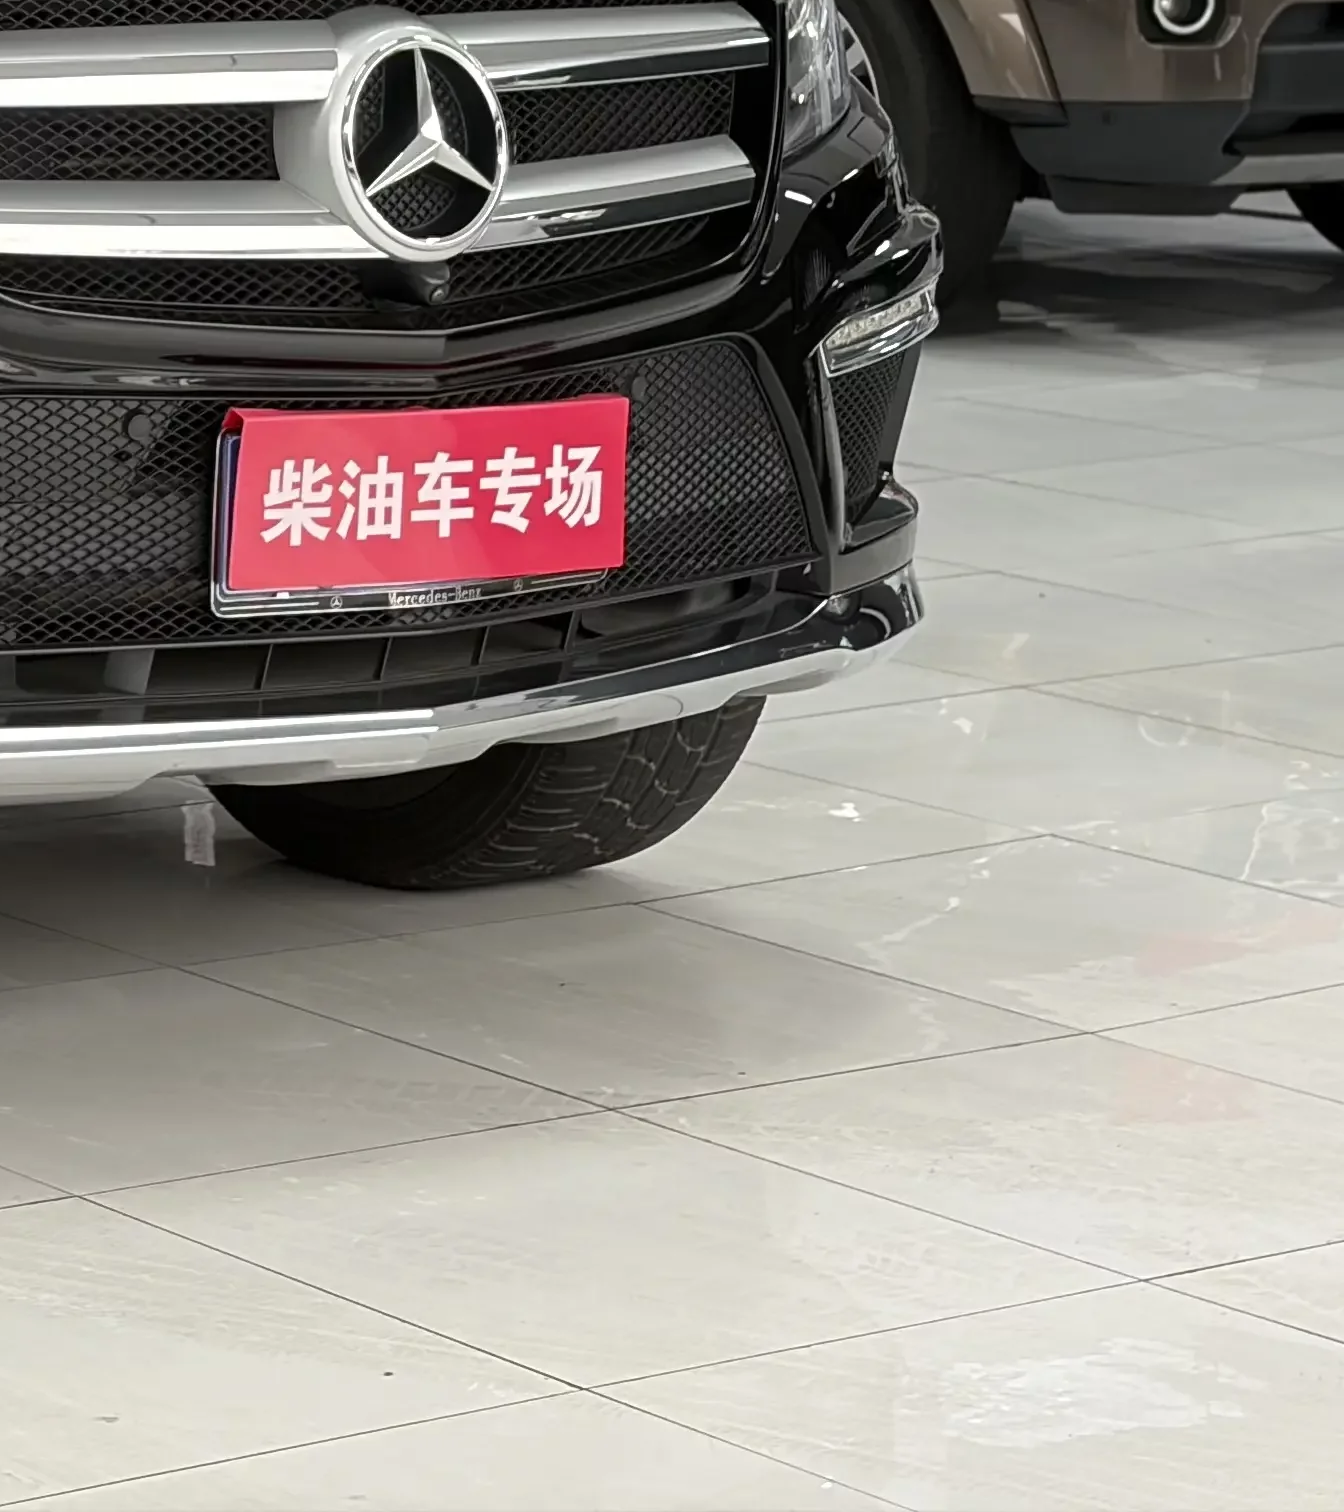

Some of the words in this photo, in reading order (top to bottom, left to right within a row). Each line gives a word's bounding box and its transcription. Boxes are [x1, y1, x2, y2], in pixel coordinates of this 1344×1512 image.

[260, 444, 603, 547] 柴油车专场
[387, 585, 482, 607] Mercedes-Benz
